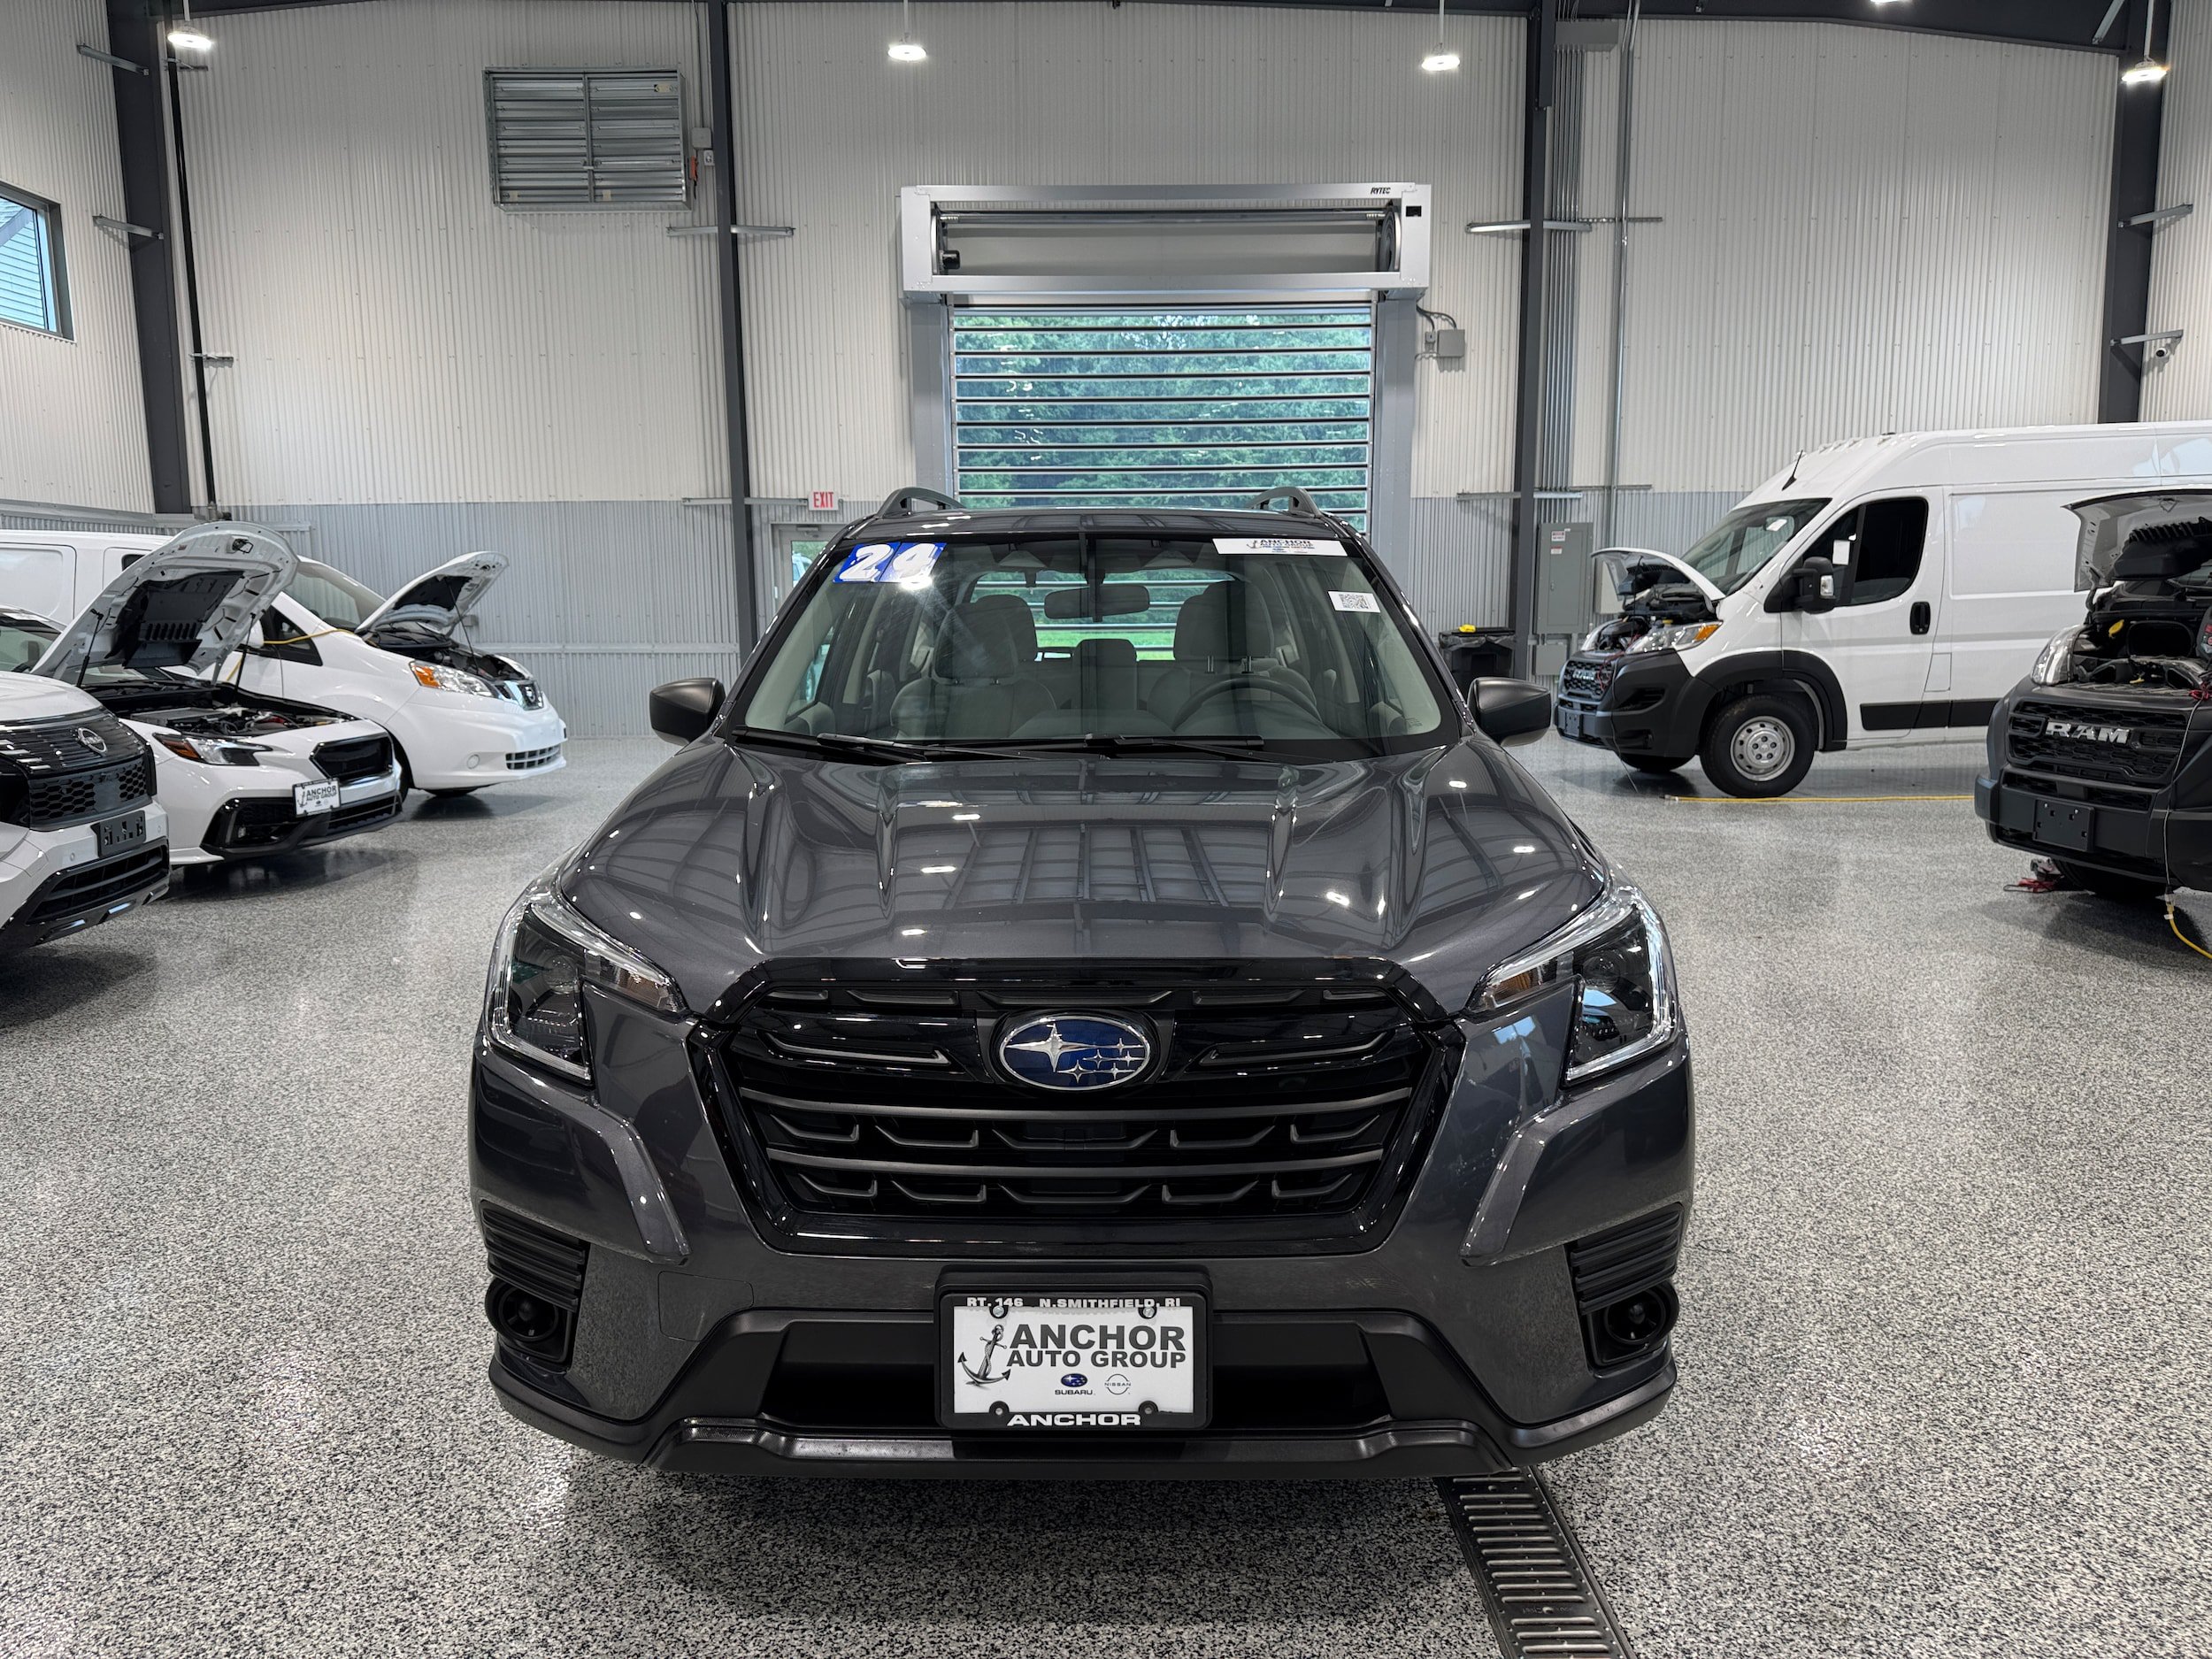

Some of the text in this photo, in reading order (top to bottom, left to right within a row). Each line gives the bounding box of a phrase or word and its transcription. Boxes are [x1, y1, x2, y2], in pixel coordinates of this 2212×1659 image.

[813, 491, 833, 508] EXIT
[839, 543, 938, 582] 24
[2045, 721, 2130, 744] RAM
[307, 786, 337, 795] ANCHOR
[966, 1297, 991, 1307] RT.
[995, 1297, 1024, 1307] 146
[1164, 1297, 1181, 1307] RI
[1010, 1324, 1186, 1351] ANCHOR
[1007, 1349, 1186, 1368] AUTO GROUP
[1007, 1414, 1141, 1426] ANCHOR
